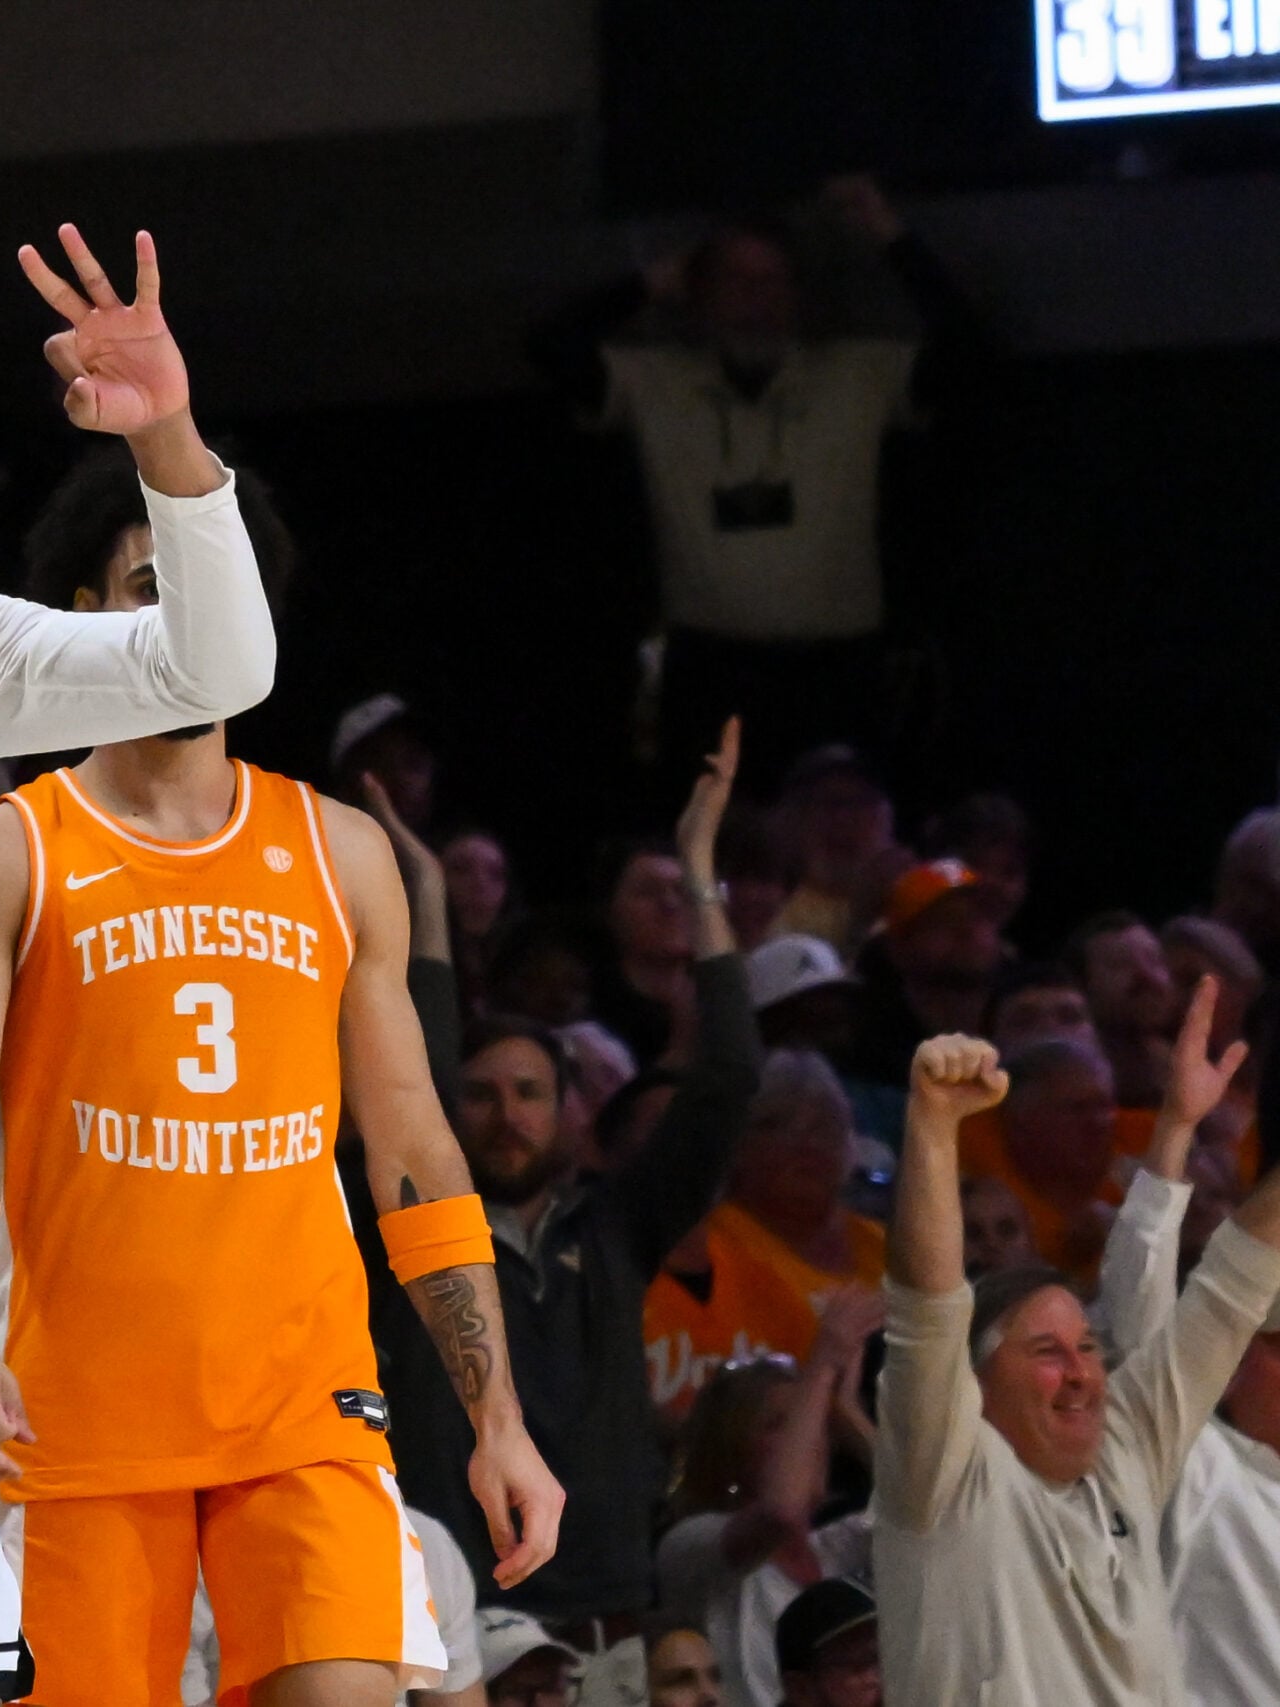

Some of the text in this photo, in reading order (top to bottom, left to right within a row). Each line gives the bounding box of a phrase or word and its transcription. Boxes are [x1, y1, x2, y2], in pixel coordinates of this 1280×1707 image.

[73, 905, 320, 985] TENNESSEE
[173, 982, 238, 1094] 3
[72, 1100, 324, 1175] VOLUNTEERS
